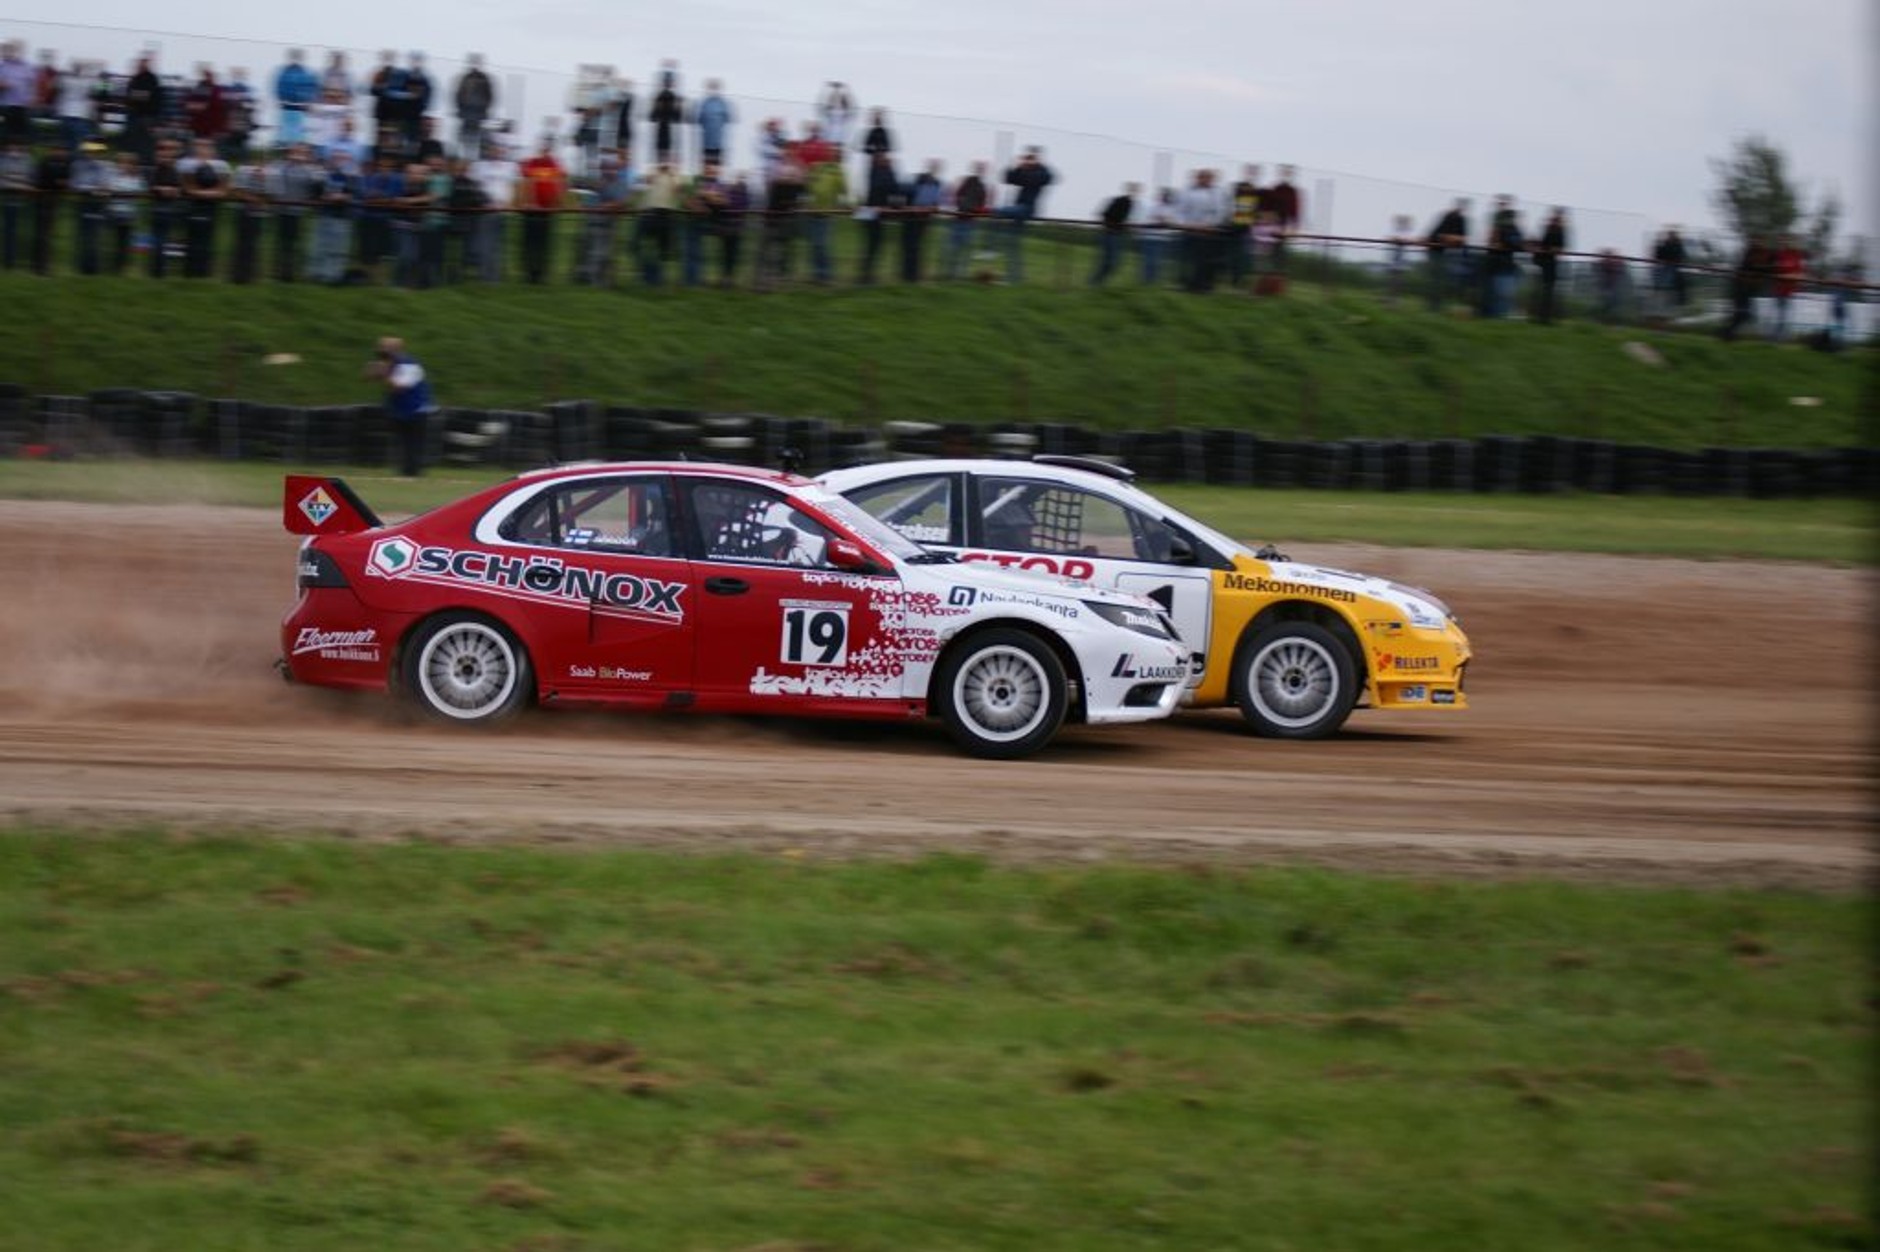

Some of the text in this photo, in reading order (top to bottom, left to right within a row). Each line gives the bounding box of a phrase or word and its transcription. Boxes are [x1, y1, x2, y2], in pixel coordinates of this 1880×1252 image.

[416, 547, 687, 617] SCHÖNOX
[1224, 573, 1357, 603] Mekonomen
[786, 610, 845, 663] 19
[569, 664, 654, 681] Saab BioPower
